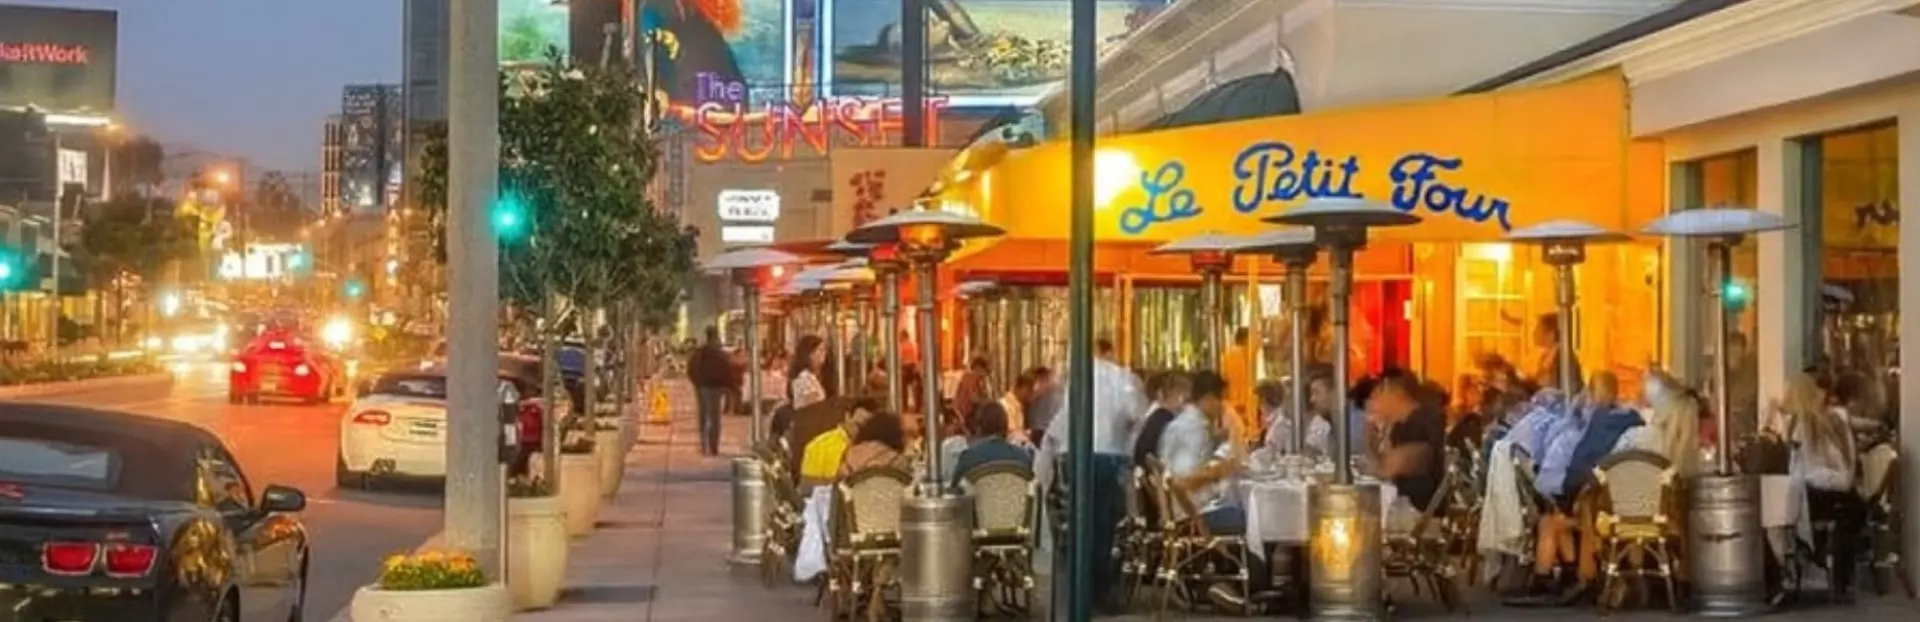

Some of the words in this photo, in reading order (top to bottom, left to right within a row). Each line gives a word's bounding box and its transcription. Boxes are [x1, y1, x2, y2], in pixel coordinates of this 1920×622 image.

[697, 72, 743, 98] The
[1119, 161, 1203, 233] Le
[1233, 142, 1364, 213] Petit
[1389, 154, 1512, 232] Four
